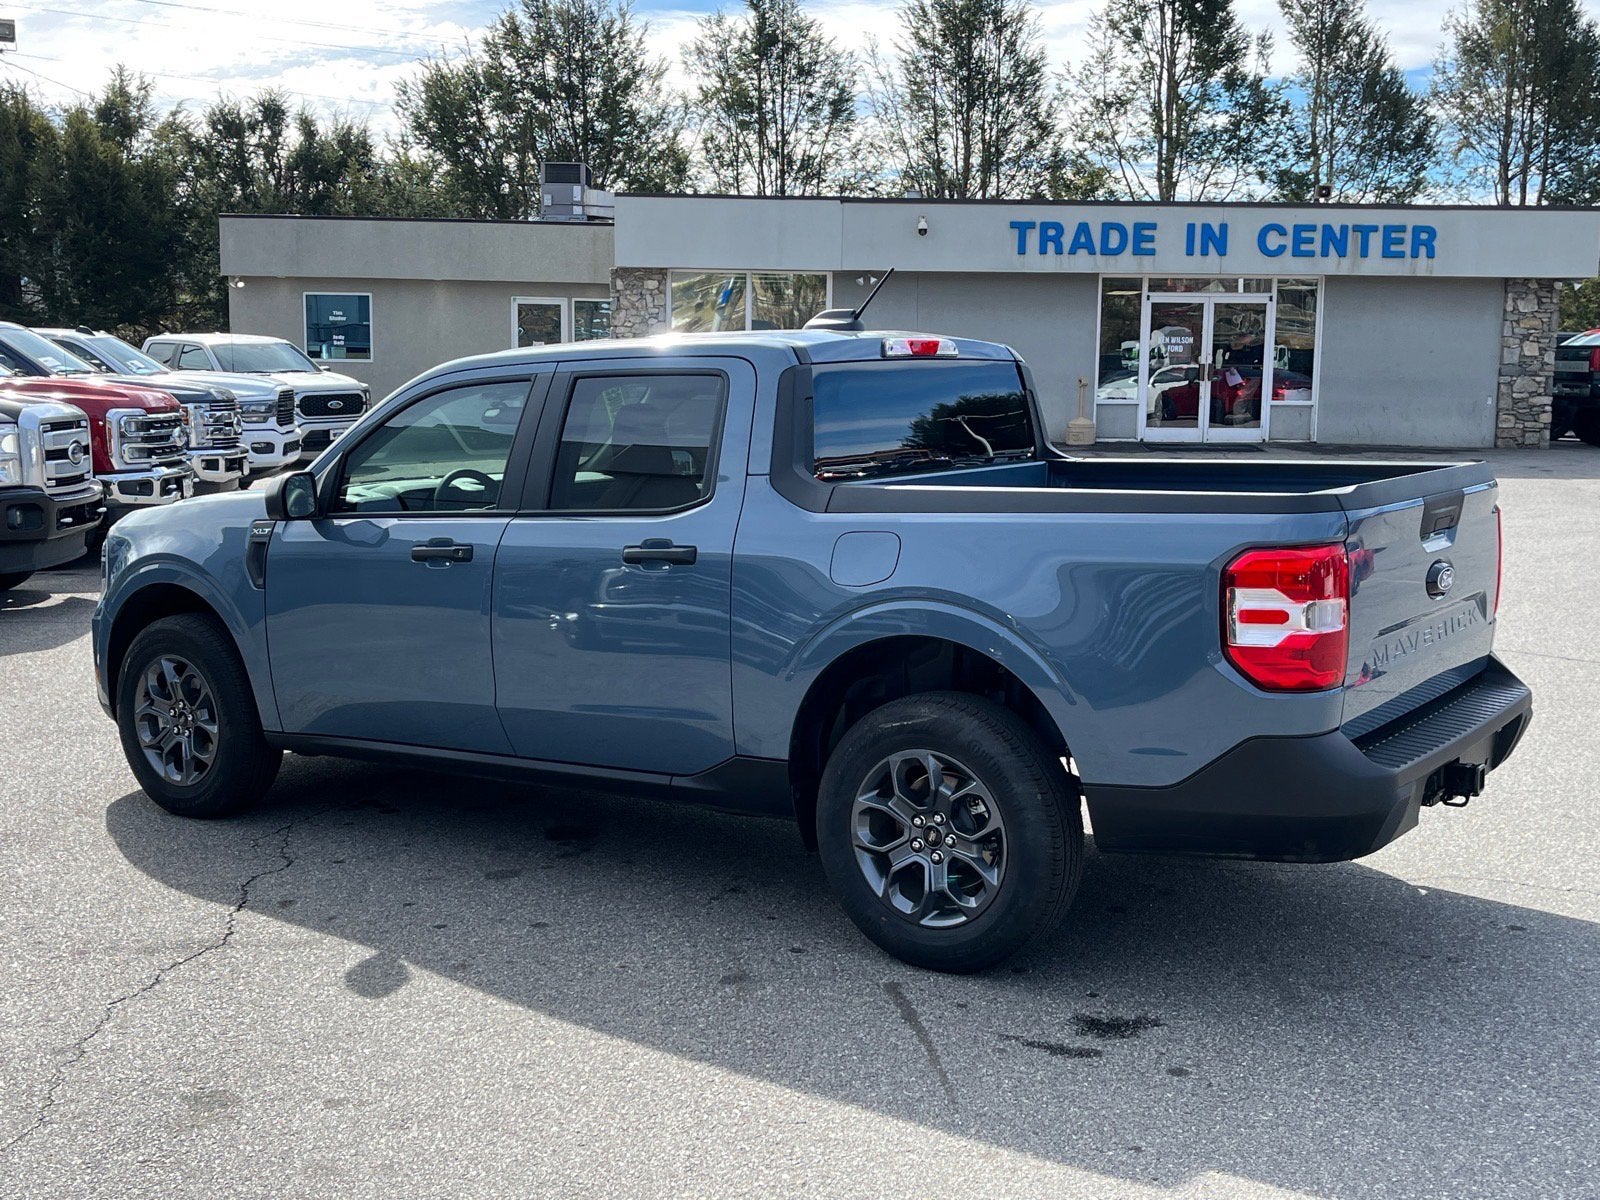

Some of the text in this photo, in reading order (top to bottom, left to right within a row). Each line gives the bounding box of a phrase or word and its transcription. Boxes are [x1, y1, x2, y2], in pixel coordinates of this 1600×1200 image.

[1009, 221, 1438, 259] TRADE IN CENTER
[1167, 345, 1184, 353] FORD
[1170, 336, 1194, 344] WILSON
[1371, 606, 1478, 670] MAVERICK
